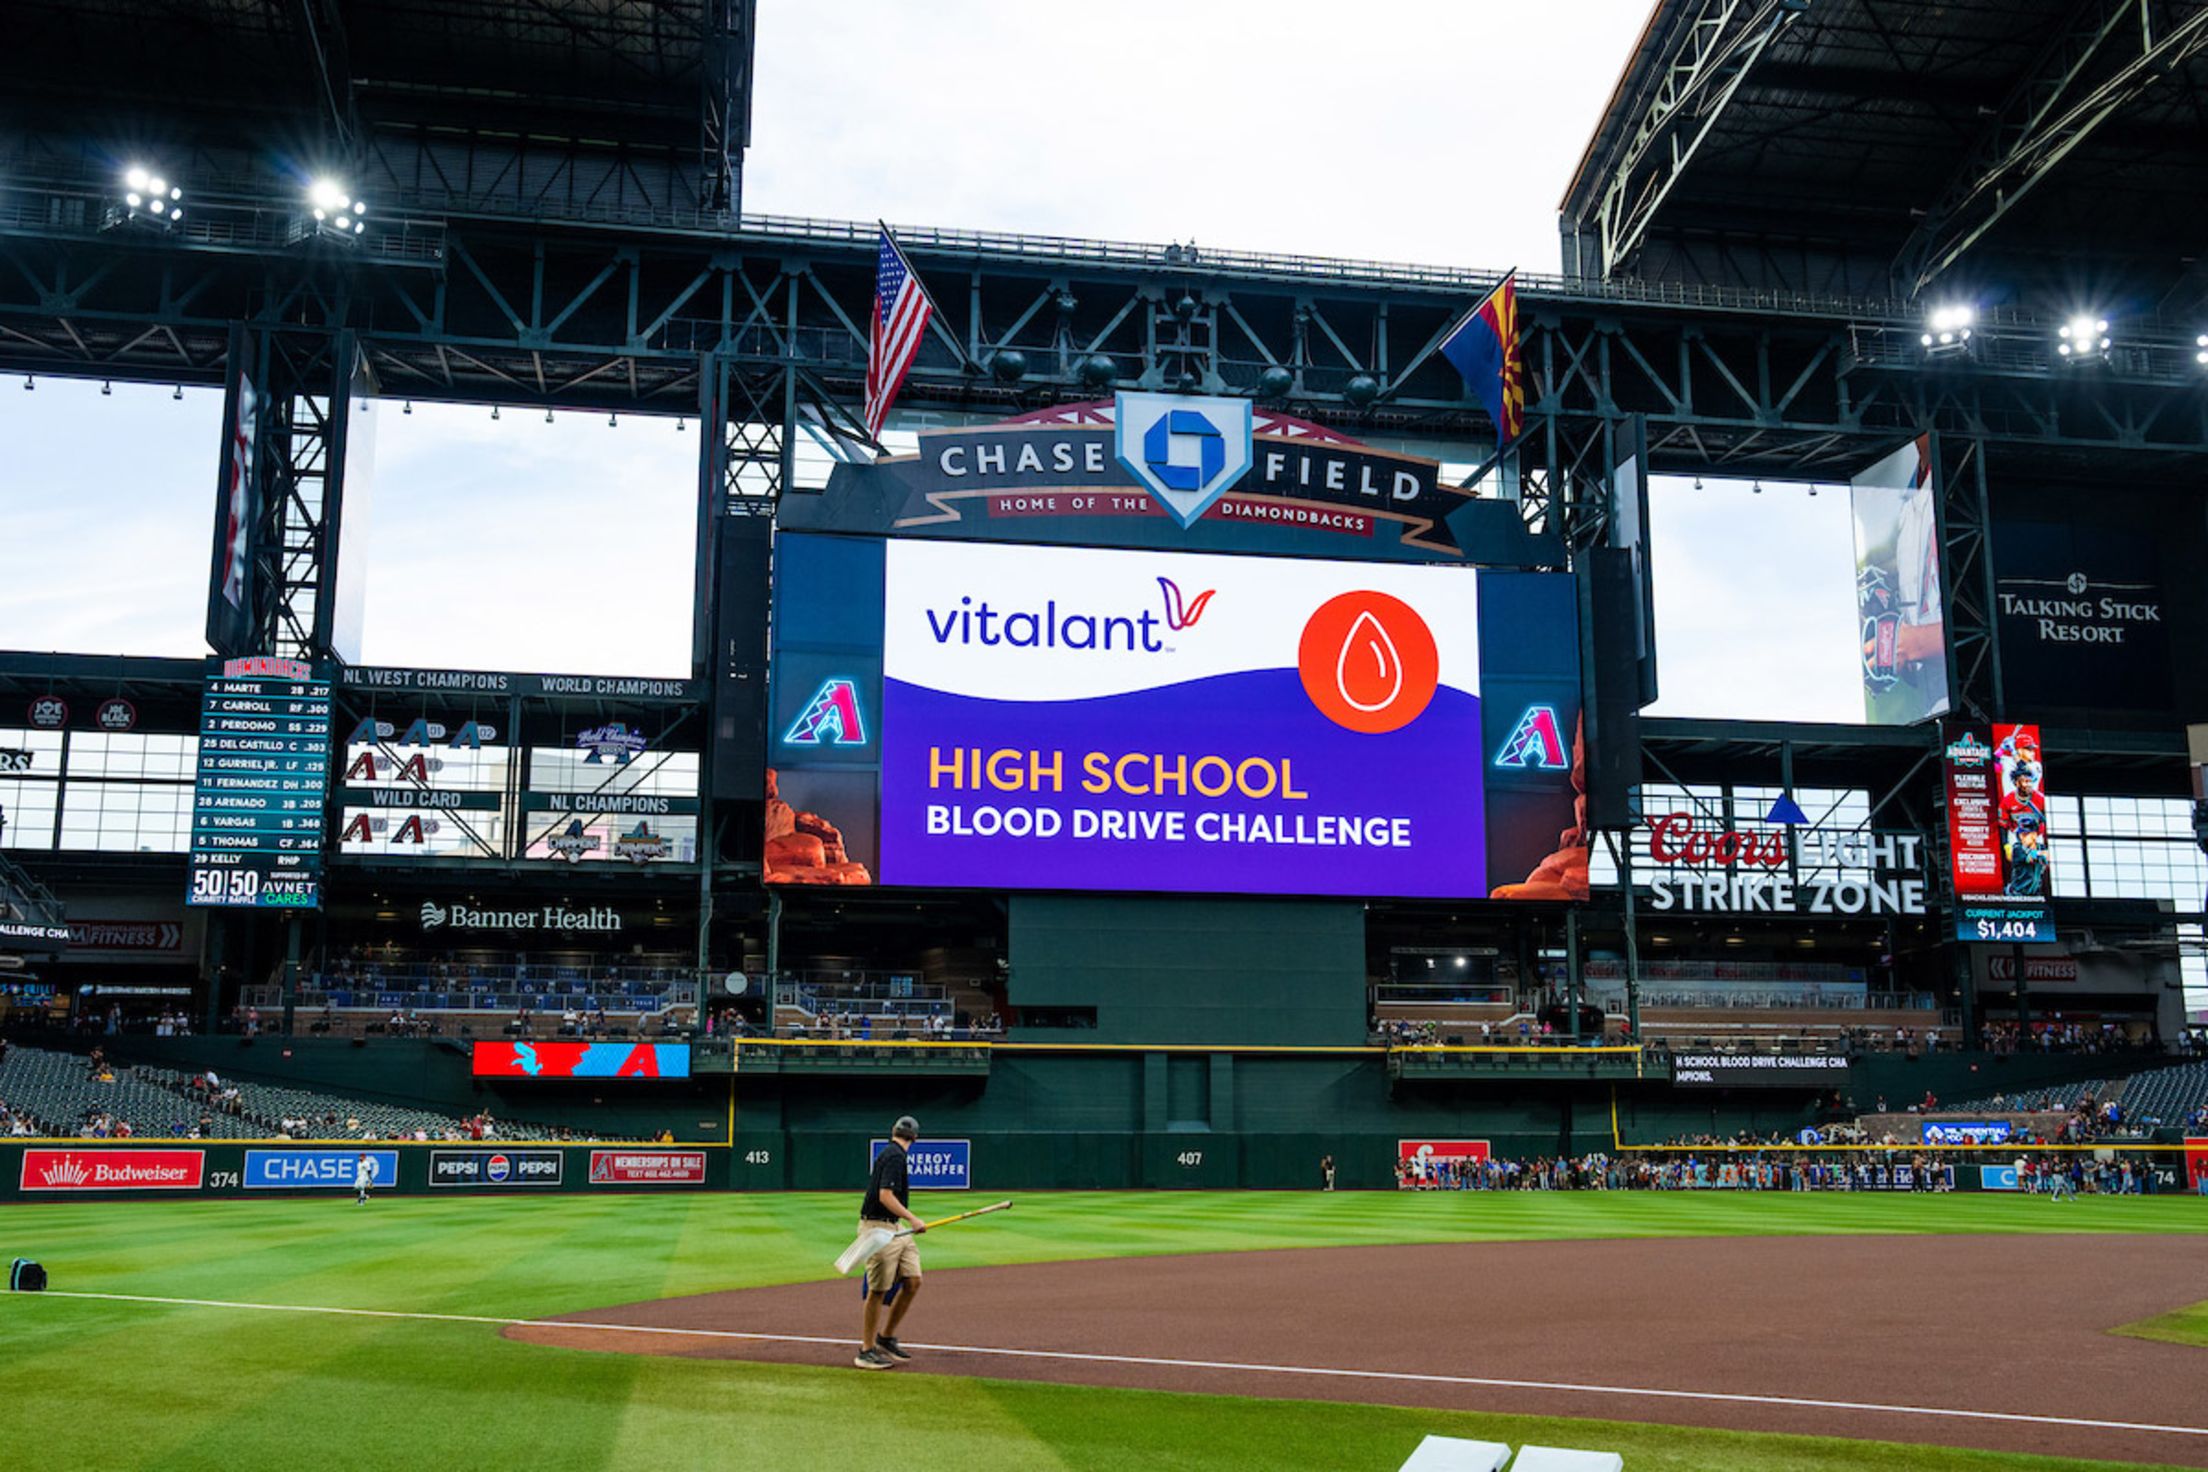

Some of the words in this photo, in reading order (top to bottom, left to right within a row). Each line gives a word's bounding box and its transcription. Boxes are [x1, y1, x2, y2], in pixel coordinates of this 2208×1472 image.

[939, 442, 1106, 477] CHASE
[1265, 452, 1421, 501] FIELD
[1000, 498, 1056, 511] HOME
[1072, 497, 1096, 509] OF
[1112, 498, 1149, 511] THE
[1221, 502, 1365, 531] DIAMONDBACKS
[926, 596, 1162, 652] vitalant
[224, 656, 312, 681] DIAMONDBACKS
[343, 670, 363, 684] NL
[368, 671, 414, 685] WEST
[417, 672, 508, 690] CHAMPIONS
[211, 682, 218, 691] 4
[224, 683, 262, 694] MARTE
[290, 686, 304, 695] 2B
[542, 677, 592, 693] WORLD
[596, 679, 684, 697] CHAMPIONS
[209, 701, 217, 709] 7
[222, 701, 271, 712] CARROLL
[288, 704, 302, 713] RF
[101, 712, 130, 722] BLACK
[207, 720, 216, 729] 2
[220, 720, 276, 731] PERDOMO
[220, 740, 238, 749] DEL
[239, 740, 284, 751] CASTILLO
[289, 742, 298, 750] C
[203, 759, 215, 767] 12
[286, 762, 298, 771] LF
[929, 747, 1063, 792] HIGH
[1081, 751, 1309, 800] SCHOOL
[203, 778, 212, 787] 11
[216, 778, 279, 789] FERNANDEZ
[283, 781, 299, 790] DH
[214, 798, 267, 808] ARENADO
[282, 800, 296, 809] 3B
[372, 789, 414, 806] WILD
[419, 791, 462, 807] CARD
[550, 795, 571, 810] NL
[575, 795, 669, 812] CHAMPIONS
[200, 817, 208, 826] 6
[213, 817, 257, 827] VARGAS
[926, 804, 1063, 838] BLOOD
[1072, 808, 1186, 842] DRIVE
[1194, 812, 1412, 848] CHALLENGE
[211, 837, 259, 847] THOMAS
[279, 839, 295, 848] CF
[1648, 811, 1790, 866] Coors
[1796, 831, 1923, 871] LIGHT
[210, 854, 242, 864] KELLY
[277, 856, 301, 866] RHP
[261, 881, 317, 894] AVNET
[228, 896, 257, 904] RAFFLE
[265, 893, 309, 905] CARES
[1651, 874, 1797, 912] STRIKE
[1809, 879, 1927, 915] ZONE
[450, 905, 539, 929] Banner
[542, 906, 622, 931] Health
[1965, 909, 2006, 919] CURRENT
[2006, 910, 2045, 919] JACKPOT
[47, 928, 69, 940] CHA
[1977, 918, 2037, 939] $1,404
[90, 931, 158, 946] FITNESS
[2027, 964, 2077, 978] FITNESS
[1675, 1057, 1683, 1067] H
[1684, 1057, 1719, 1068] SCHOOL
[1721, 1057, 1750, 1068] BLOOD
[1752, 1057, 1777, 1068] DRIVE
[1777, 1057, 1827, 1068] CHALLENGE
[1828, 1058, 1848, 1068] CHA
[615, 1156, 668, 1169] MEMBERSHIPS
[671, 1157, 681, 1168] ON
[683, 1156, 702, 1169] SALE
[745, 1151, 770, 1164] 413
[906, 1153, 952, 1165] NERGY
[1177, 1153, 1202, 1166] 407
[94, 1163, 188, 1182] Budweiser
[264, 1158, 353, 1180] CHASE
[438, 1161, 479, 1174] PEPSI
[518, 1161, 557, 1174] PEPSI
[906, 1164, 965, 1176] RANSFER
[210, 1171, 239, 1188] 374
